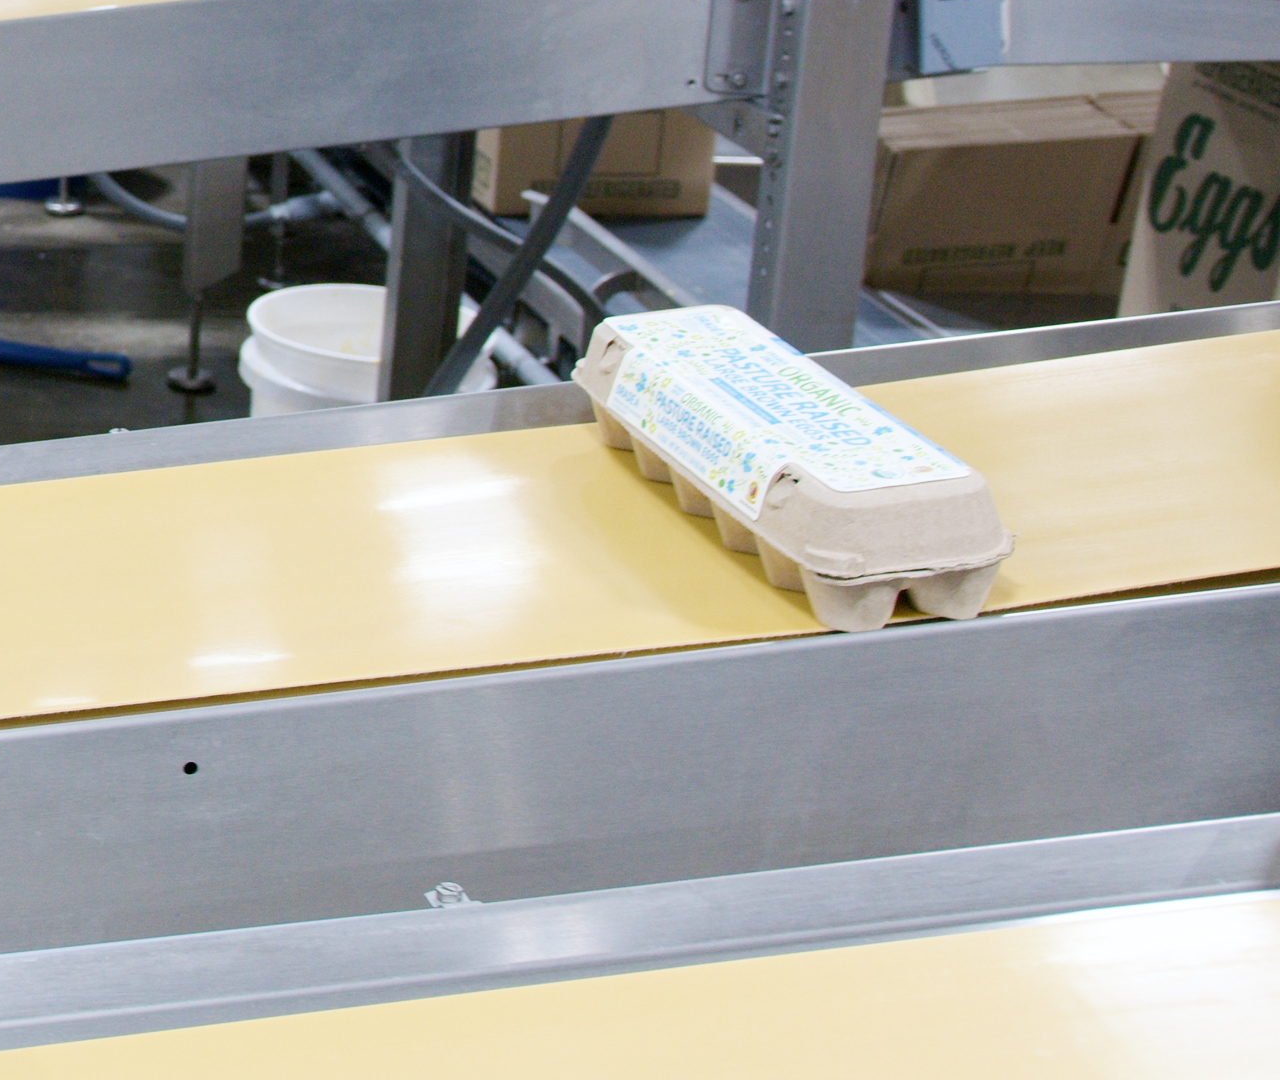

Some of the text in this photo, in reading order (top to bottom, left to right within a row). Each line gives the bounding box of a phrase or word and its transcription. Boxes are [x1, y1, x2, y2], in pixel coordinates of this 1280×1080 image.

[654, 390, 697, 432] PASTURE
[695, 421, 733, 458] RAISED
[680, 392, 724, 425] ORGANIC
[702, 358, 750, 385] LARGE
[740, 384, 797, 418] BROWN
[787, 418, 831, 441] EGGS
[712, 347, 805, 400] PASTURE
[788, 400, 872, 446] RAISED
[777, 366, 863, 417] ORGANIC
